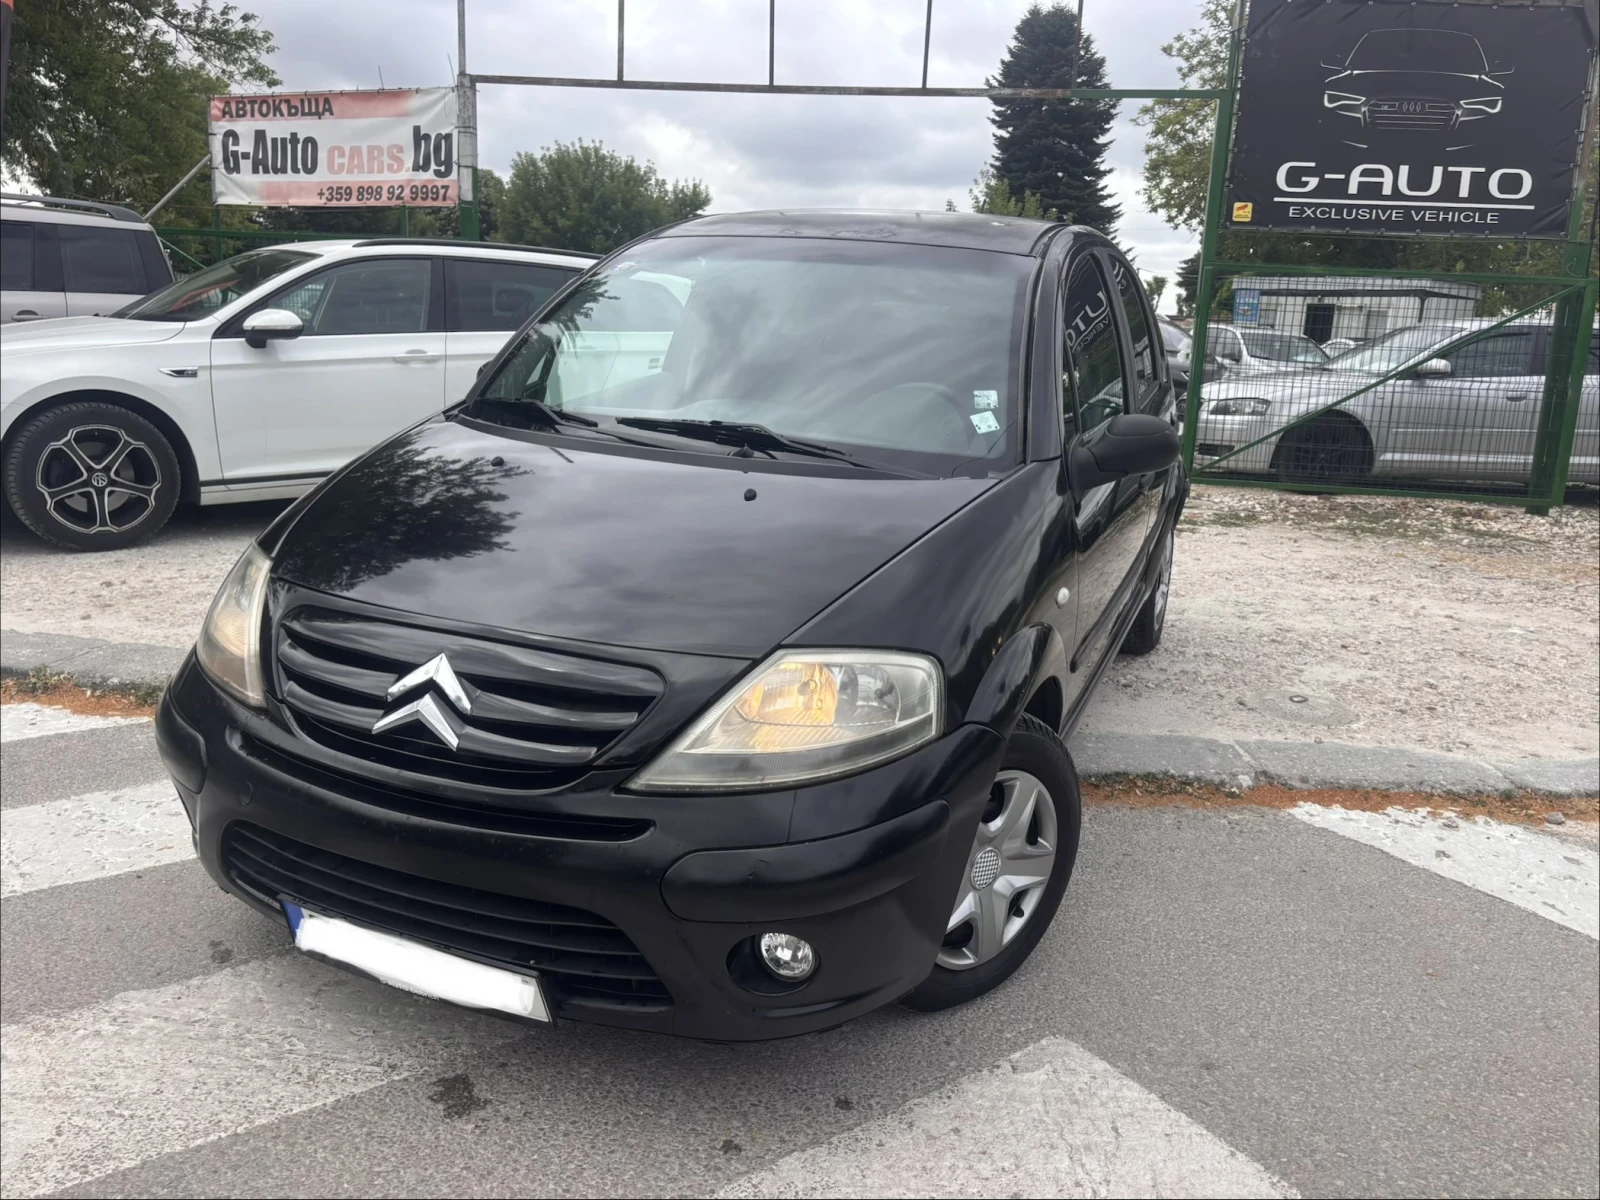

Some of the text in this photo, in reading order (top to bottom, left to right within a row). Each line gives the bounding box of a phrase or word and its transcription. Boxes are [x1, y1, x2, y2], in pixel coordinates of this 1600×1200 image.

[221, 97, 334, 120] АВТОКЪЩА
[221, 129, 319, 175] G-Auto
[1275, 161, 1533, 200] G-AUTO
[317, 185, 450, 202] +359 898 92 9997
[1288, 206, 1500, 225] EXCLUSIVE VEHICLE
